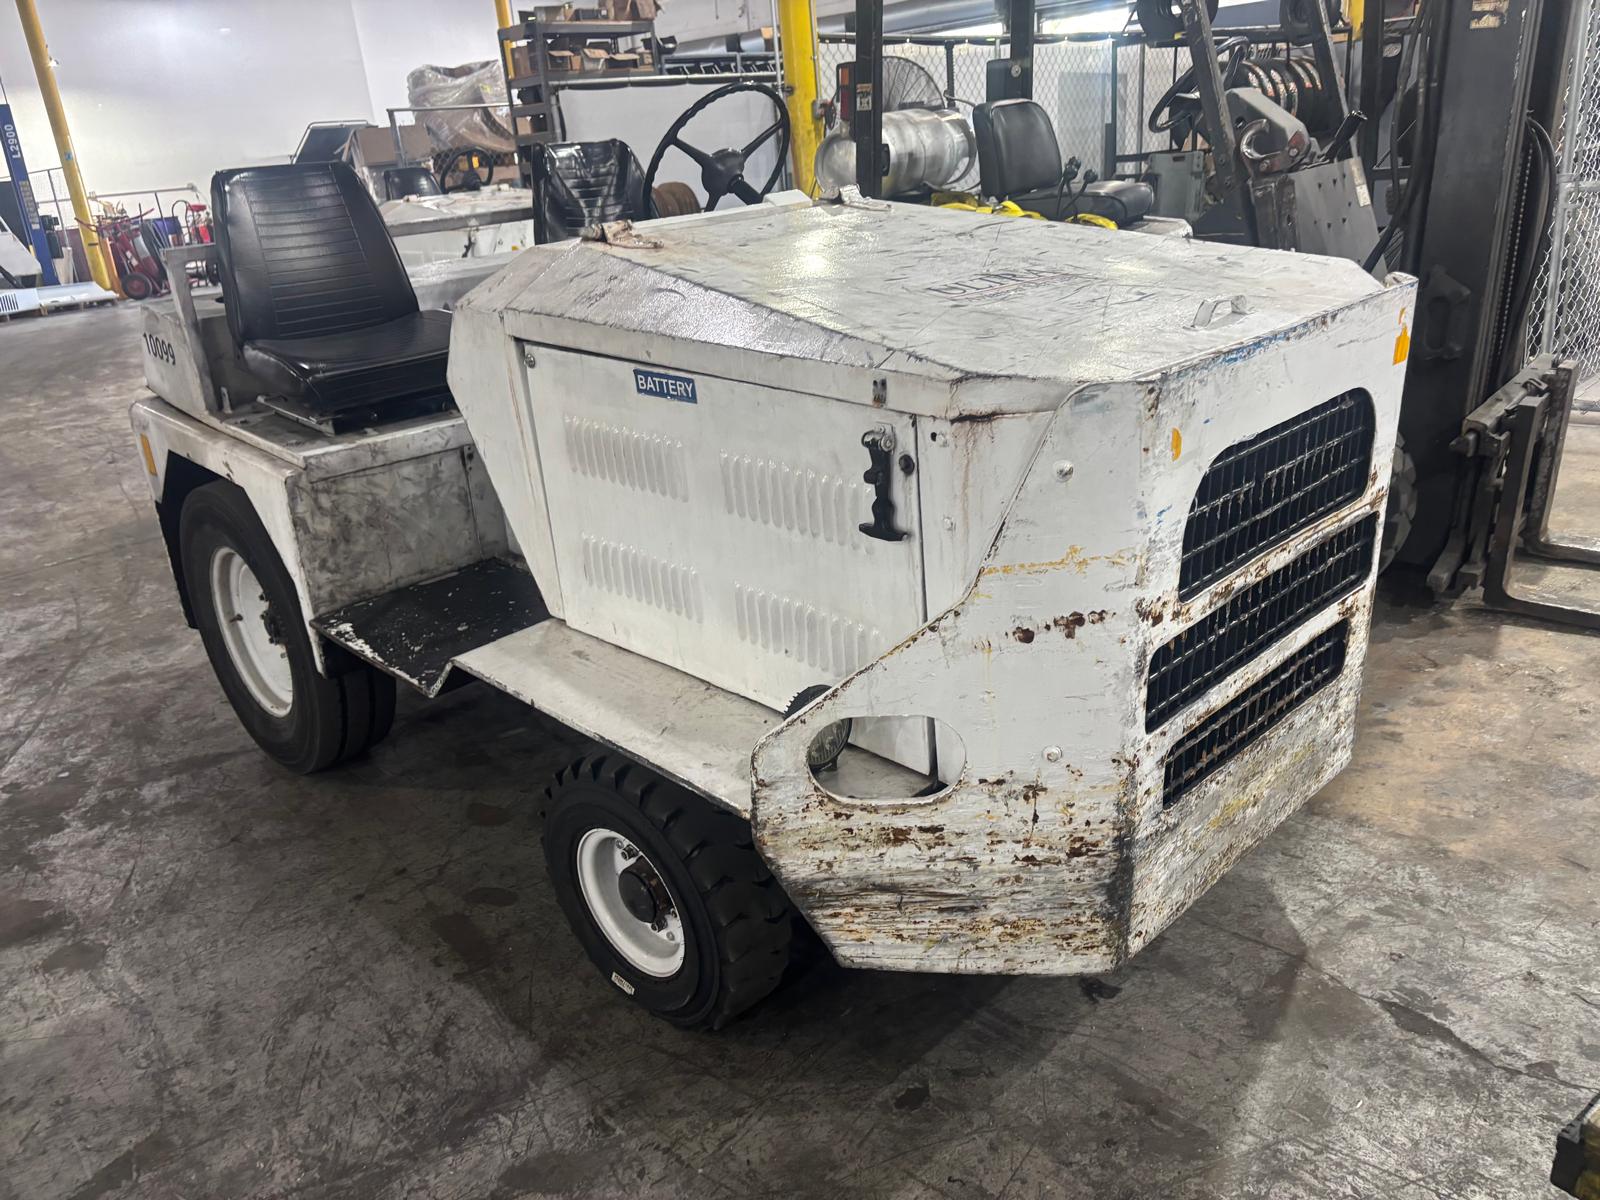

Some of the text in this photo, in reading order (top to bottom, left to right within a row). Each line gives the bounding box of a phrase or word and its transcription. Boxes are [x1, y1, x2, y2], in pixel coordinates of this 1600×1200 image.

[4, 124, 21, 158] L2900
[142, 332, 176, 366] 10099
[637, 374, 693, 399] BATTERY
